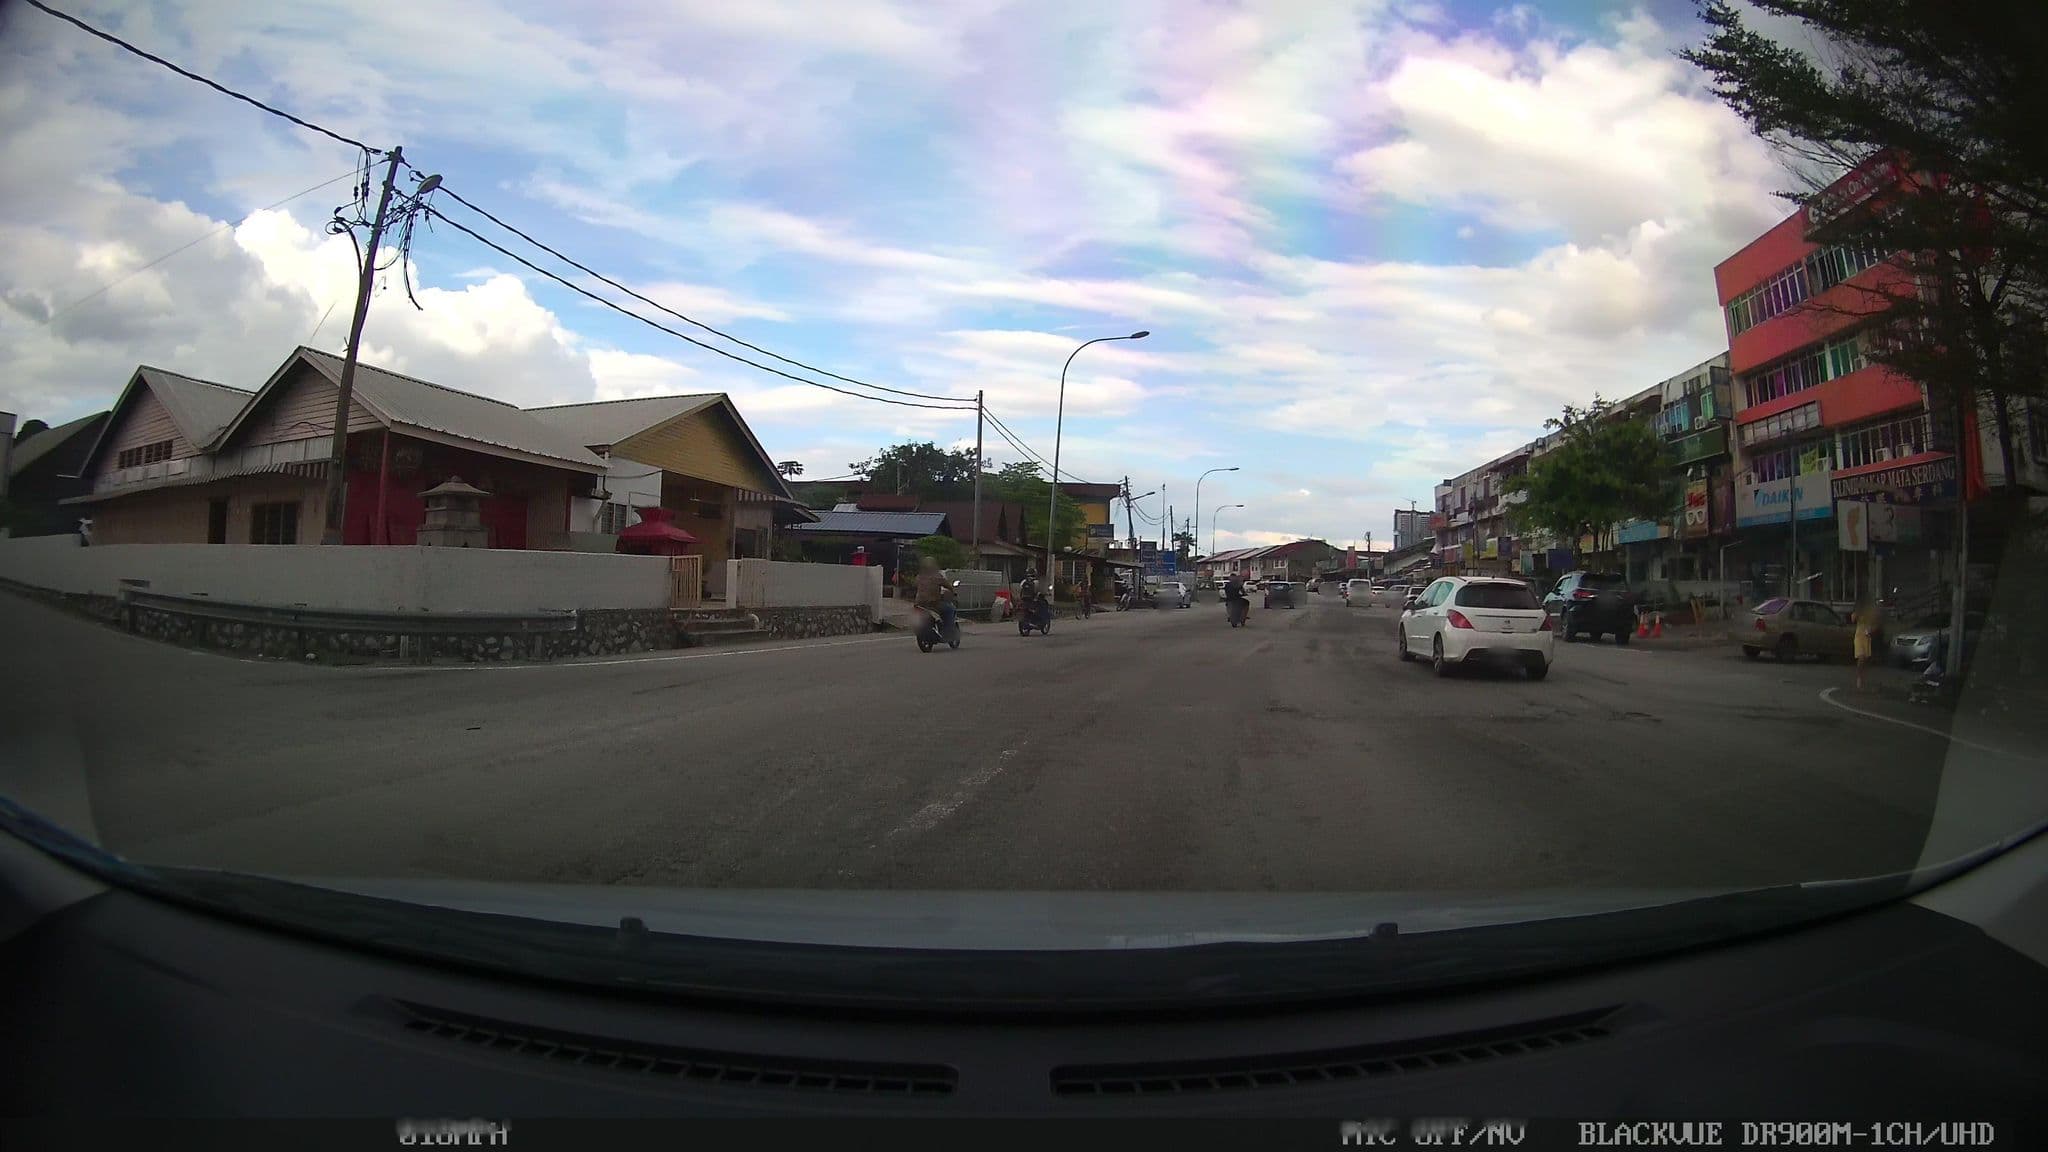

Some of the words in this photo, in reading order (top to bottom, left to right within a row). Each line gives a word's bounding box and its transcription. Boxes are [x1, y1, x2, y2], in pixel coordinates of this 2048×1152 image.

[1887, 469, 1911, 489] MATA
[1911, 459, 1955, 487] SERDANG
[1761, 487, 1804, 506] DAIKN
